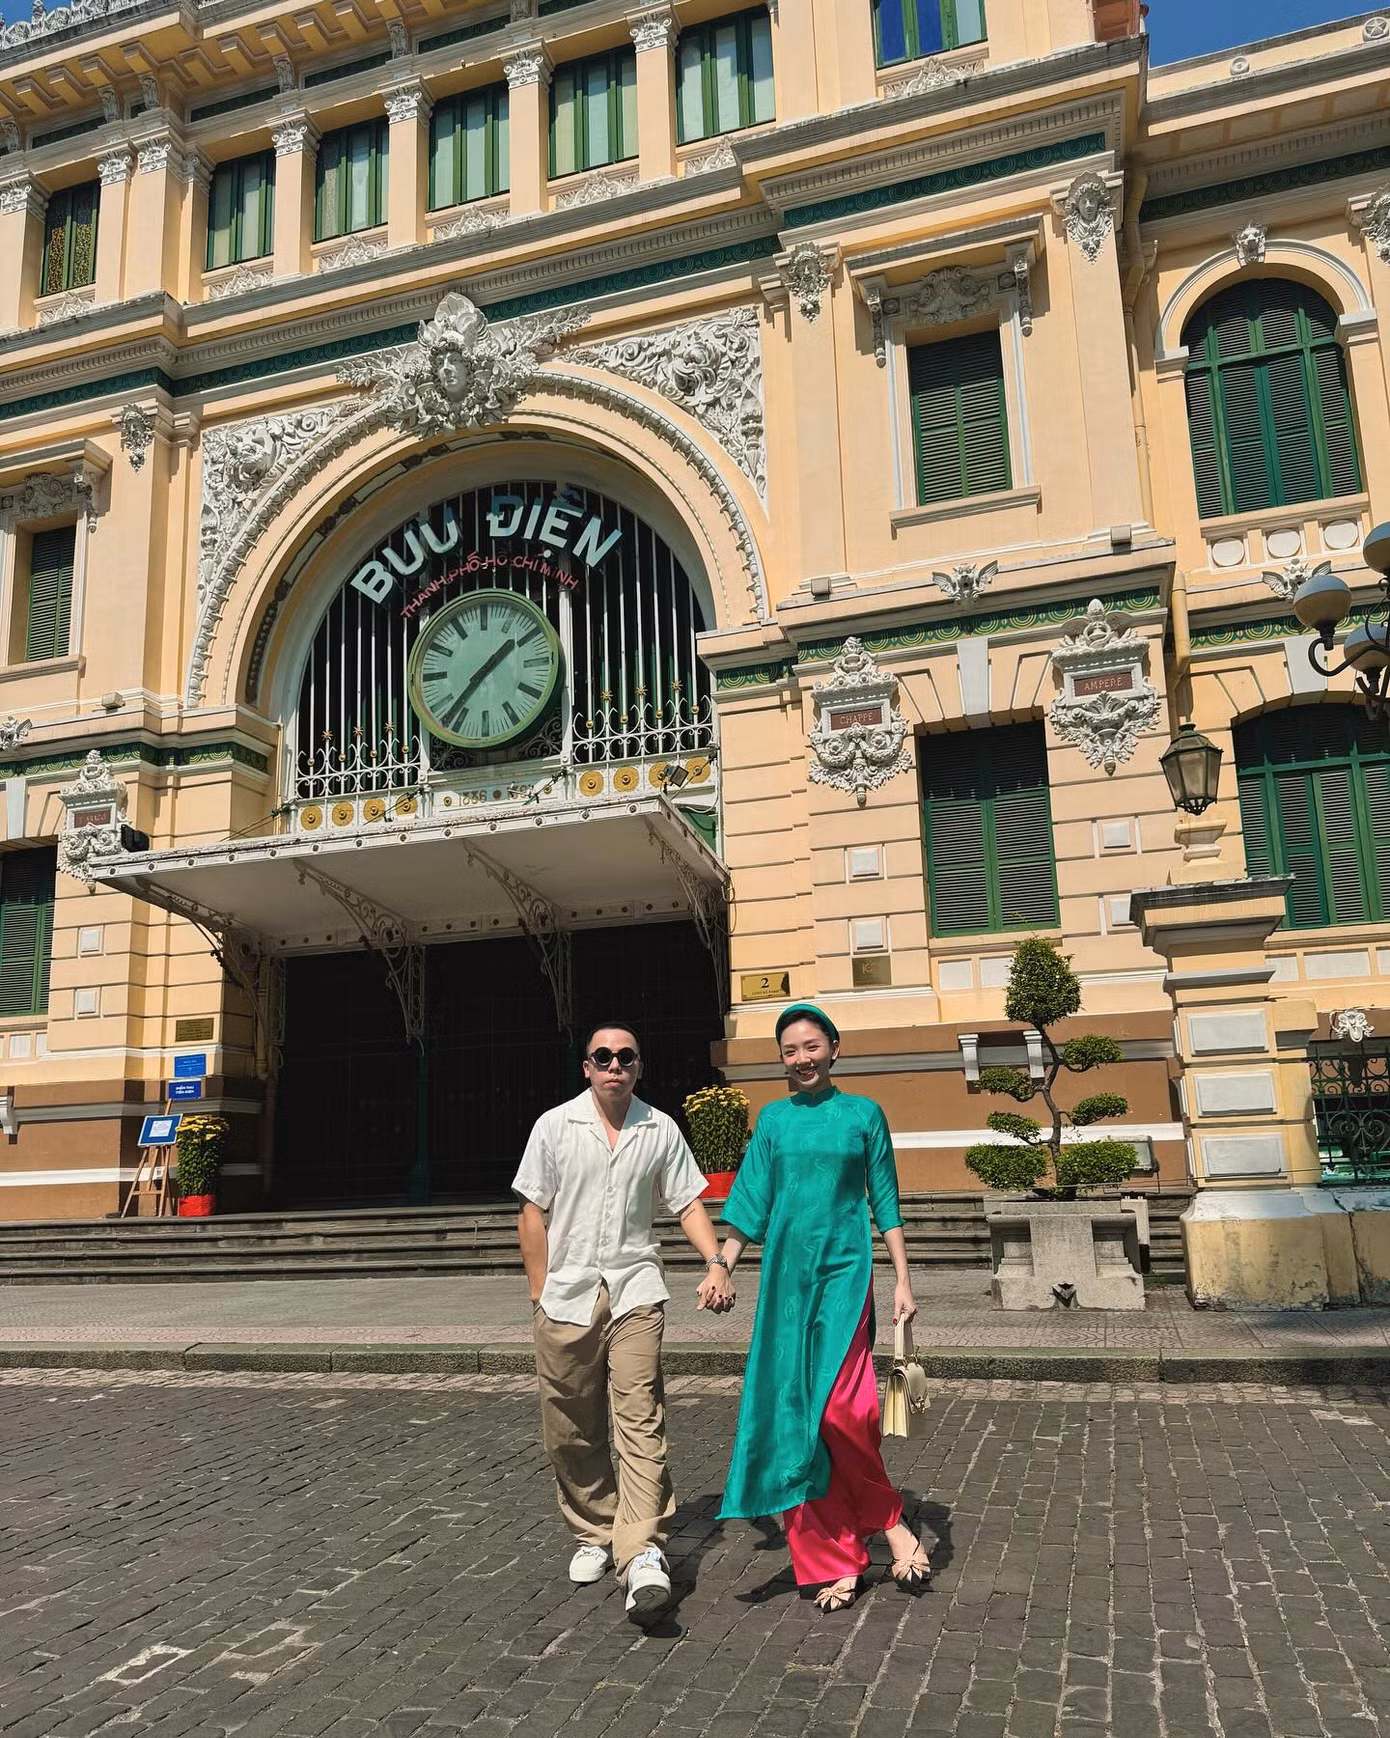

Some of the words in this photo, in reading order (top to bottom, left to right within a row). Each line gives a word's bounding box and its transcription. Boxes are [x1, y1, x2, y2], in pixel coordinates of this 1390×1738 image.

[486, 488, 623, 568] ĐIỆN
[839, 712, 874, 724] CHAPPE
[761, 978, 769, 988] 2
